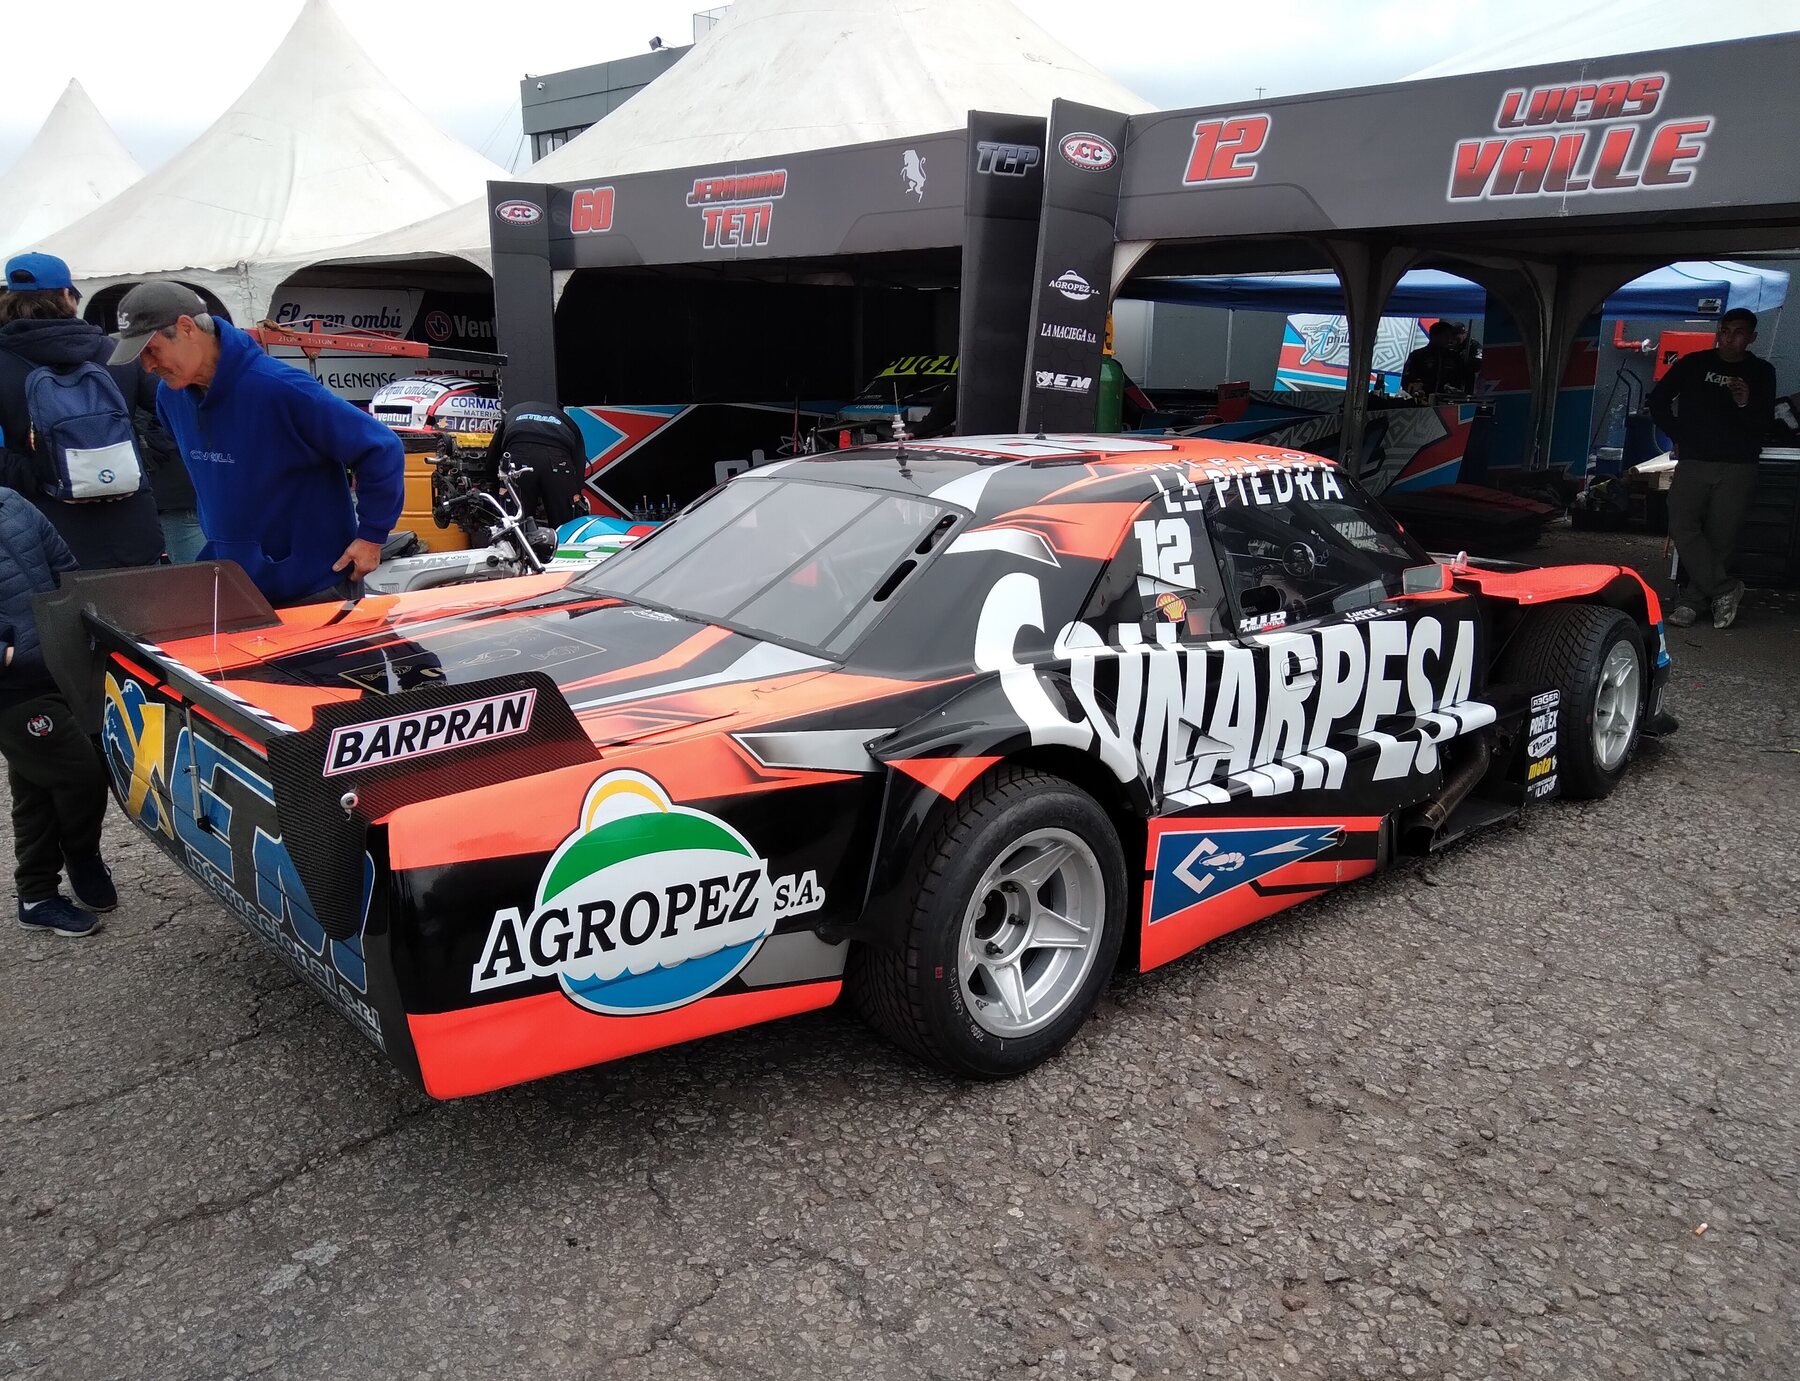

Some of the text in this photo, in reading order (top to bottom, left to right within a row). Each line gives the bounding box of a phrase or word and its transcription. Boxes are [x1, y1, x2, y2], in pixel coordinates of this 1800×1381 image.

[1497, 76, 1666, 129] LUCAS
[977, 141, 1040, 176] TCP
[1184, 116, 1268, 183] 12
[1450, 120, 1712, 199] VALLE
[571, 187, 614, 232] 60
[703, 203, 773, 248] TETI
[1048, 280, 1091, 293] AGROPEZ
[276, 302, 299, 328] El
[351, 306, 402, 329] ombú
[1041, 323, 1052, 337] LA
[1052, 325, 1087, 342] MACIEGA
[1150, 461, 1345, 513] LA PIEDRA
[1134, 518, 1197, 597] 12
[332, 696, 527, 769] BARPRAN
[480, 868, 821, 981] AGROPEZ S.A.
